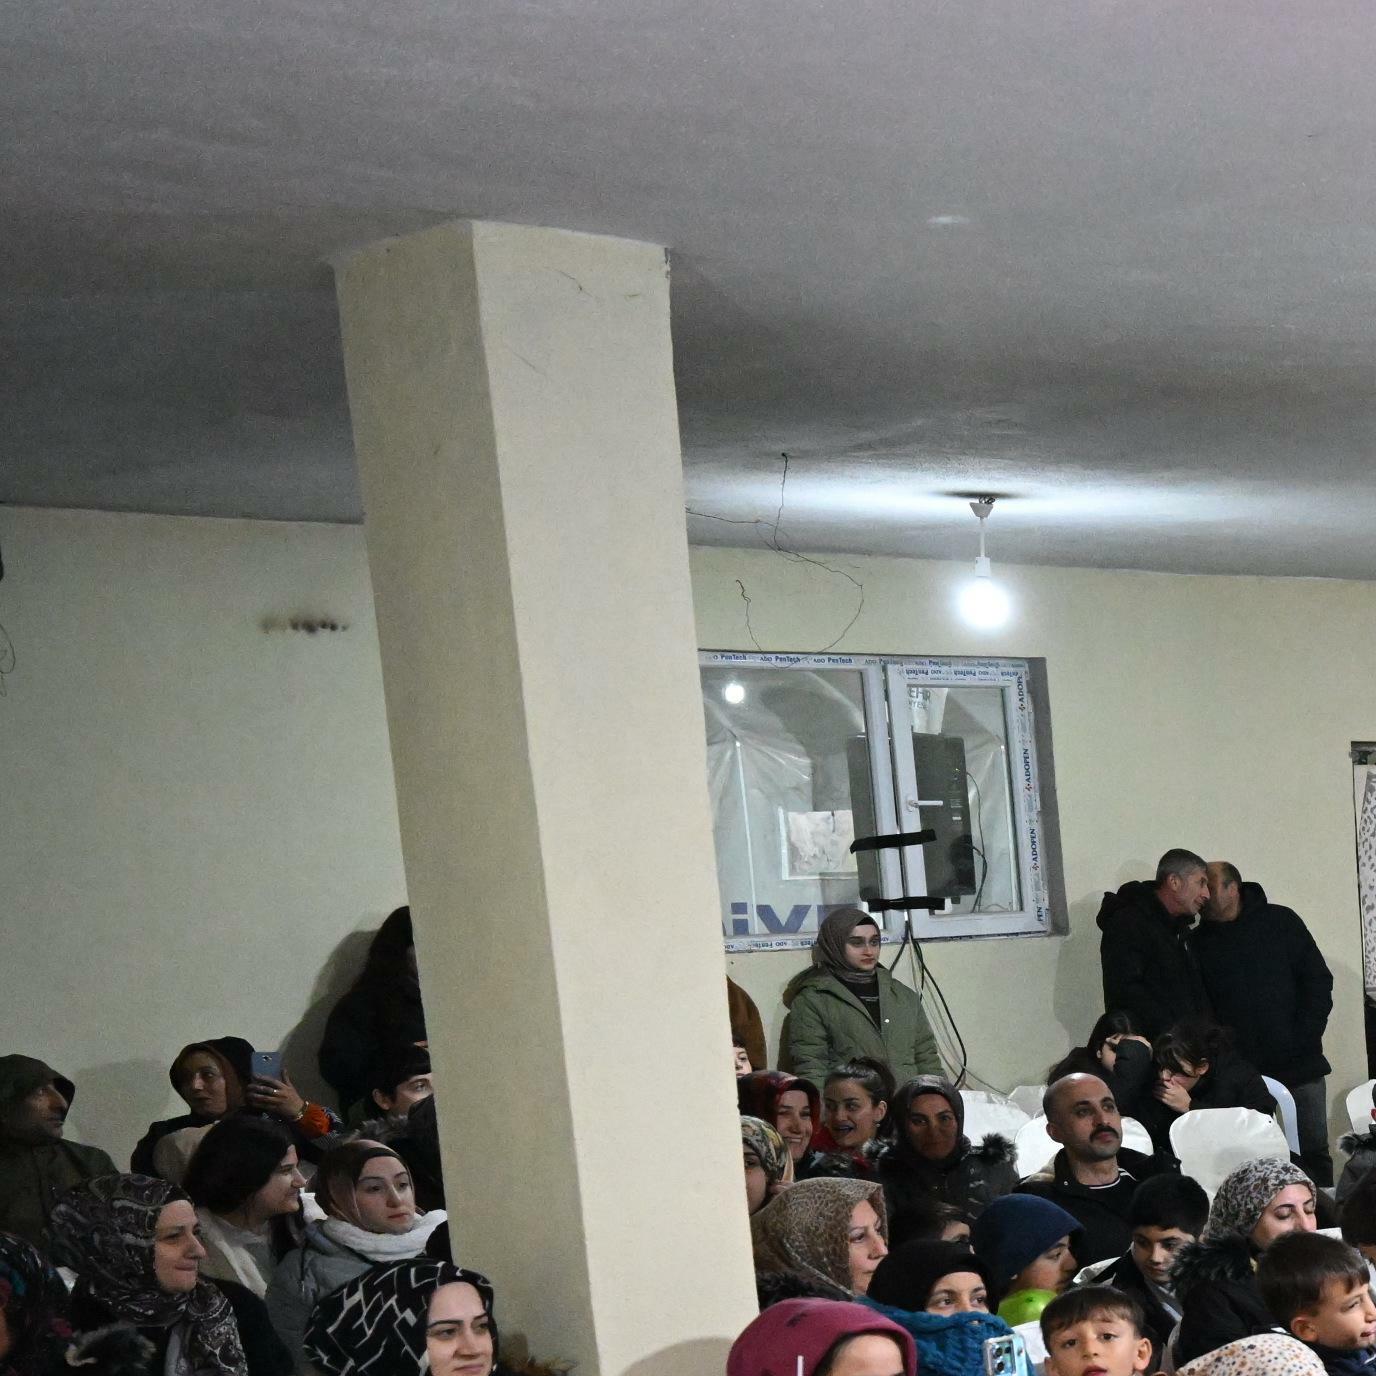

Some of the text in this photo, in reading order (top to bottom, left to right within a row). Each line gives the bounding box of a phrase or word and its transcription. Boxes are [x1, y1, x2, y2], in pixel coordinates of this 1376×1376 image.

[906, 668, 929, 676] PenTech
[1023, 748, 1031, 783] ADOPEN
[1030, 828, 1038, 862] ADOPEN
